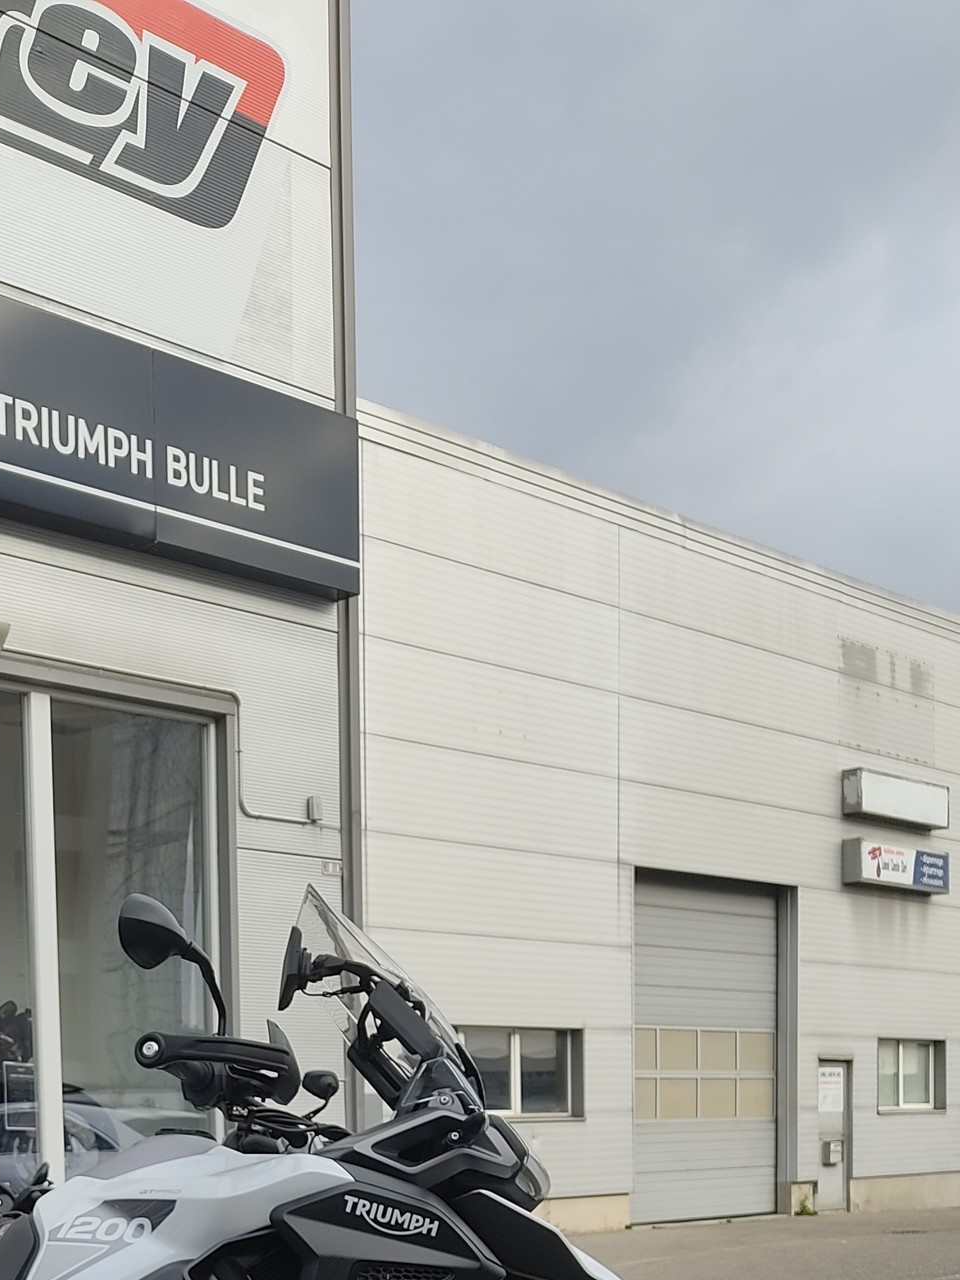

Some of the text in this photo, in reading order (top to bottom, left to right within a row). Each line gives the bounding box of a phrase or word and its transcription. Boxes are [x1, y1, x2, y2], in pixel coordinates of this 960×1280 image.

[166, 446, 266, 512] BULLE
[57, 1216, 152, 1243] 1200
[344, 1194, 440, 1237] TRIUMPH
